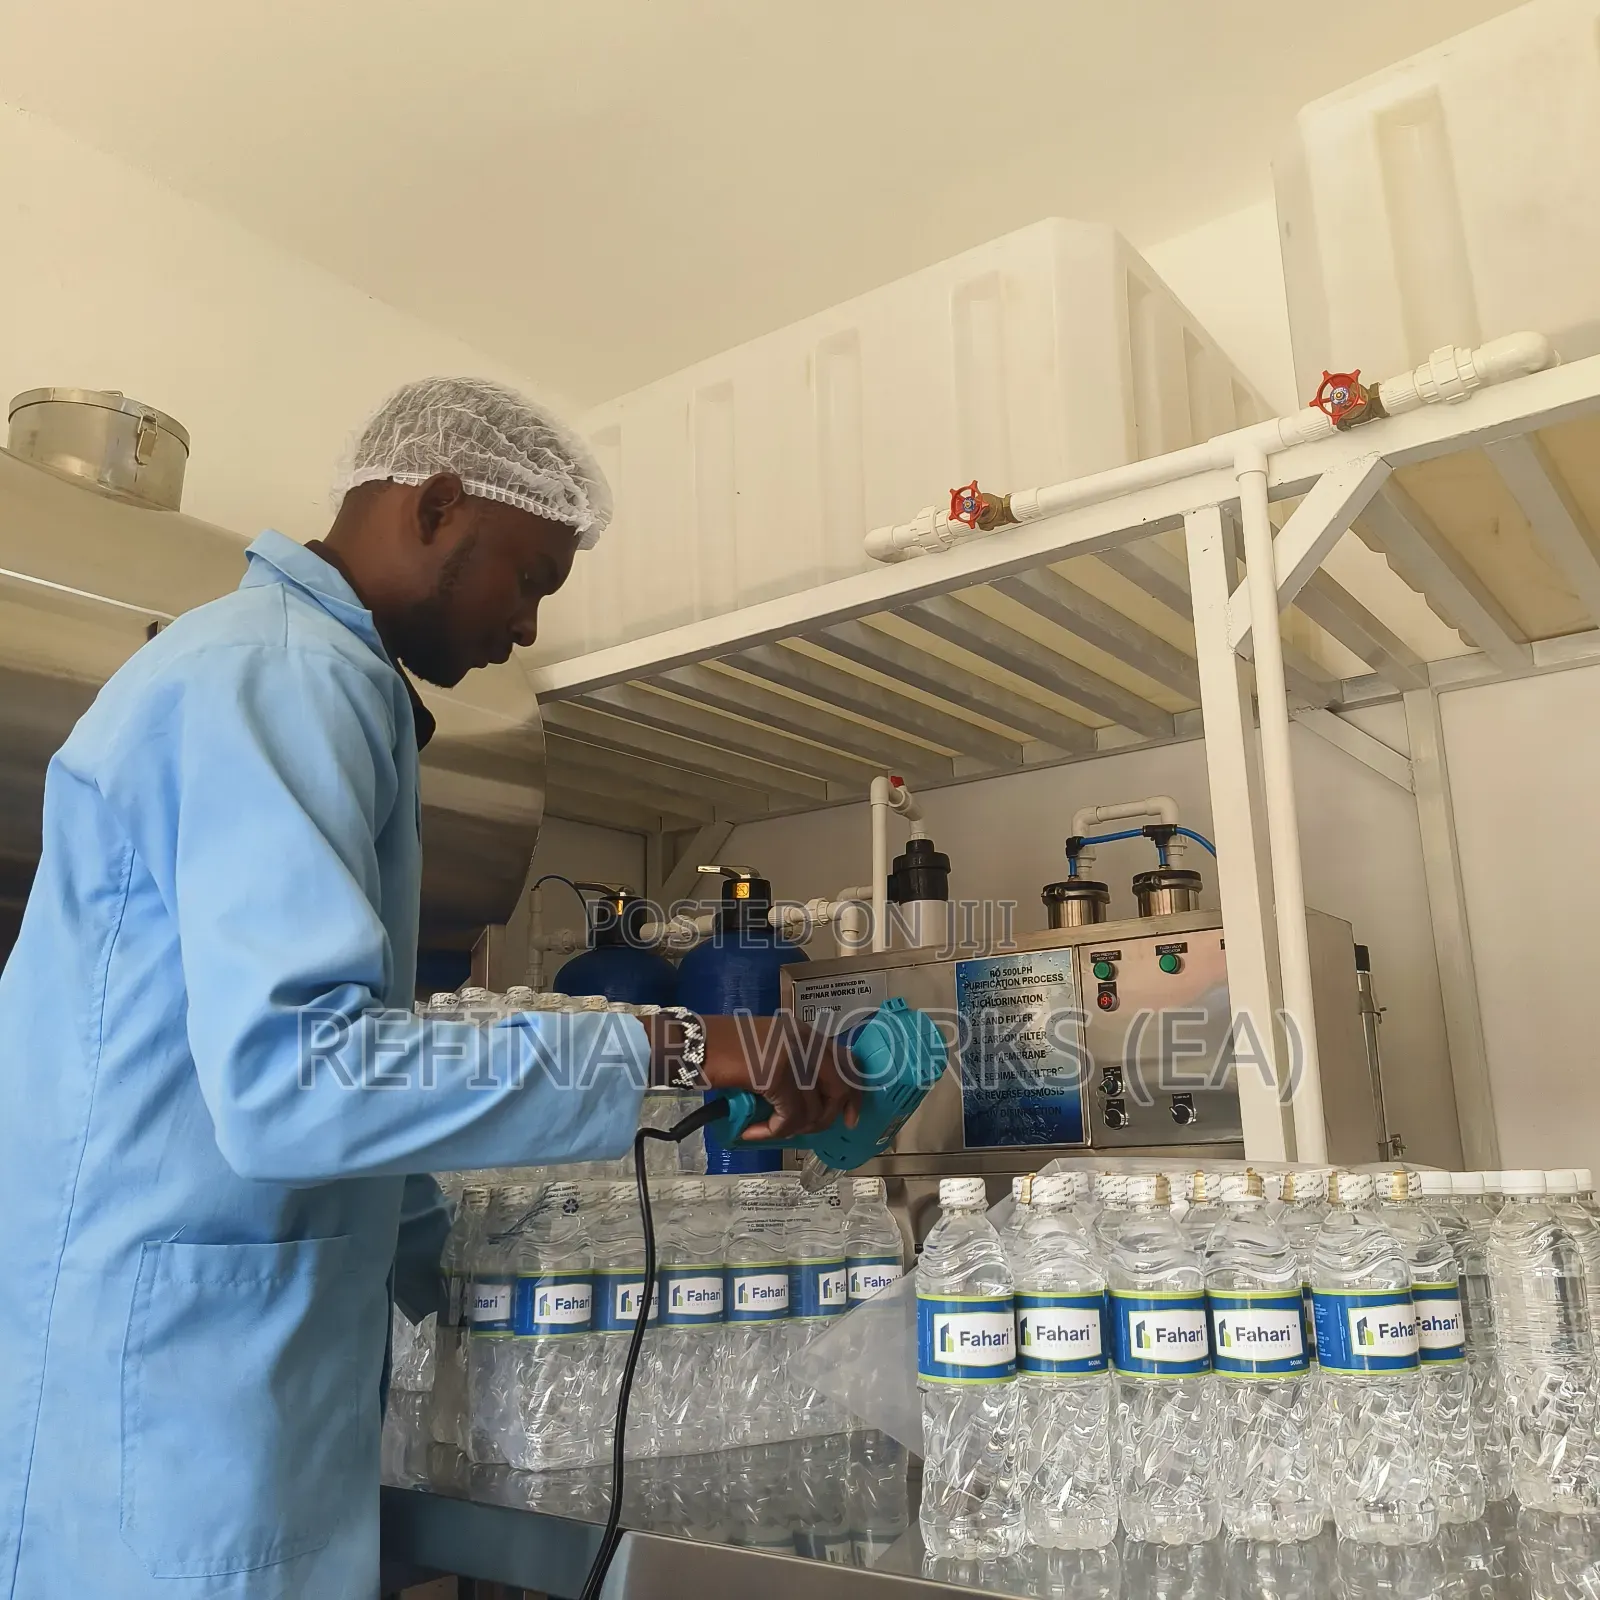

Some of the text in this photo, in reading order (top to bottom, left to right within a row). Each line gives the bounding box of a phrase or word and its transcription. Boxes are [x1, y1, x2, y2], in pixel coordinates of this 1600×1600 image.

[990, 966, 1033, 978] RO 500LPH
[964, 973, 1064, 991] PURIFICATION PROCESS
[800, 986, 872, 1000] REFINAR WORKS (EA)
[980, 994, 1043, 1008] CHLORINATION
[982, 1016, 1004, 1026] SAND
[1005, 1013, 1033, 1024] FILTER
[982, 1033, 1017, 1043] CARBON
[1020, 1031, 1047, 1041] FILTER
[995, 1050, 1047, 1061] MEMBRANE
[985, 1070, 1029, 1080] SEDIMENT
[1030, 1068, 1058, 1078] FILTER
[985, 1088, 1022, 1099] REVERSE
[1024, 1087, 1065, 1098] OSMOSIS
[687, 1288, 721, 1302] Fahari
[752, 1284, 786, 1298] Fahari
[555, 1295, 591, 1310] Fahari
[960, 1328, 1009, 1347] Fahari
[1036, 1324, 1090, 1342] Fahari
[1156, 1325, 1204, 1343] Fahari
[1235, 1325, 1291, 1342] Fahari
